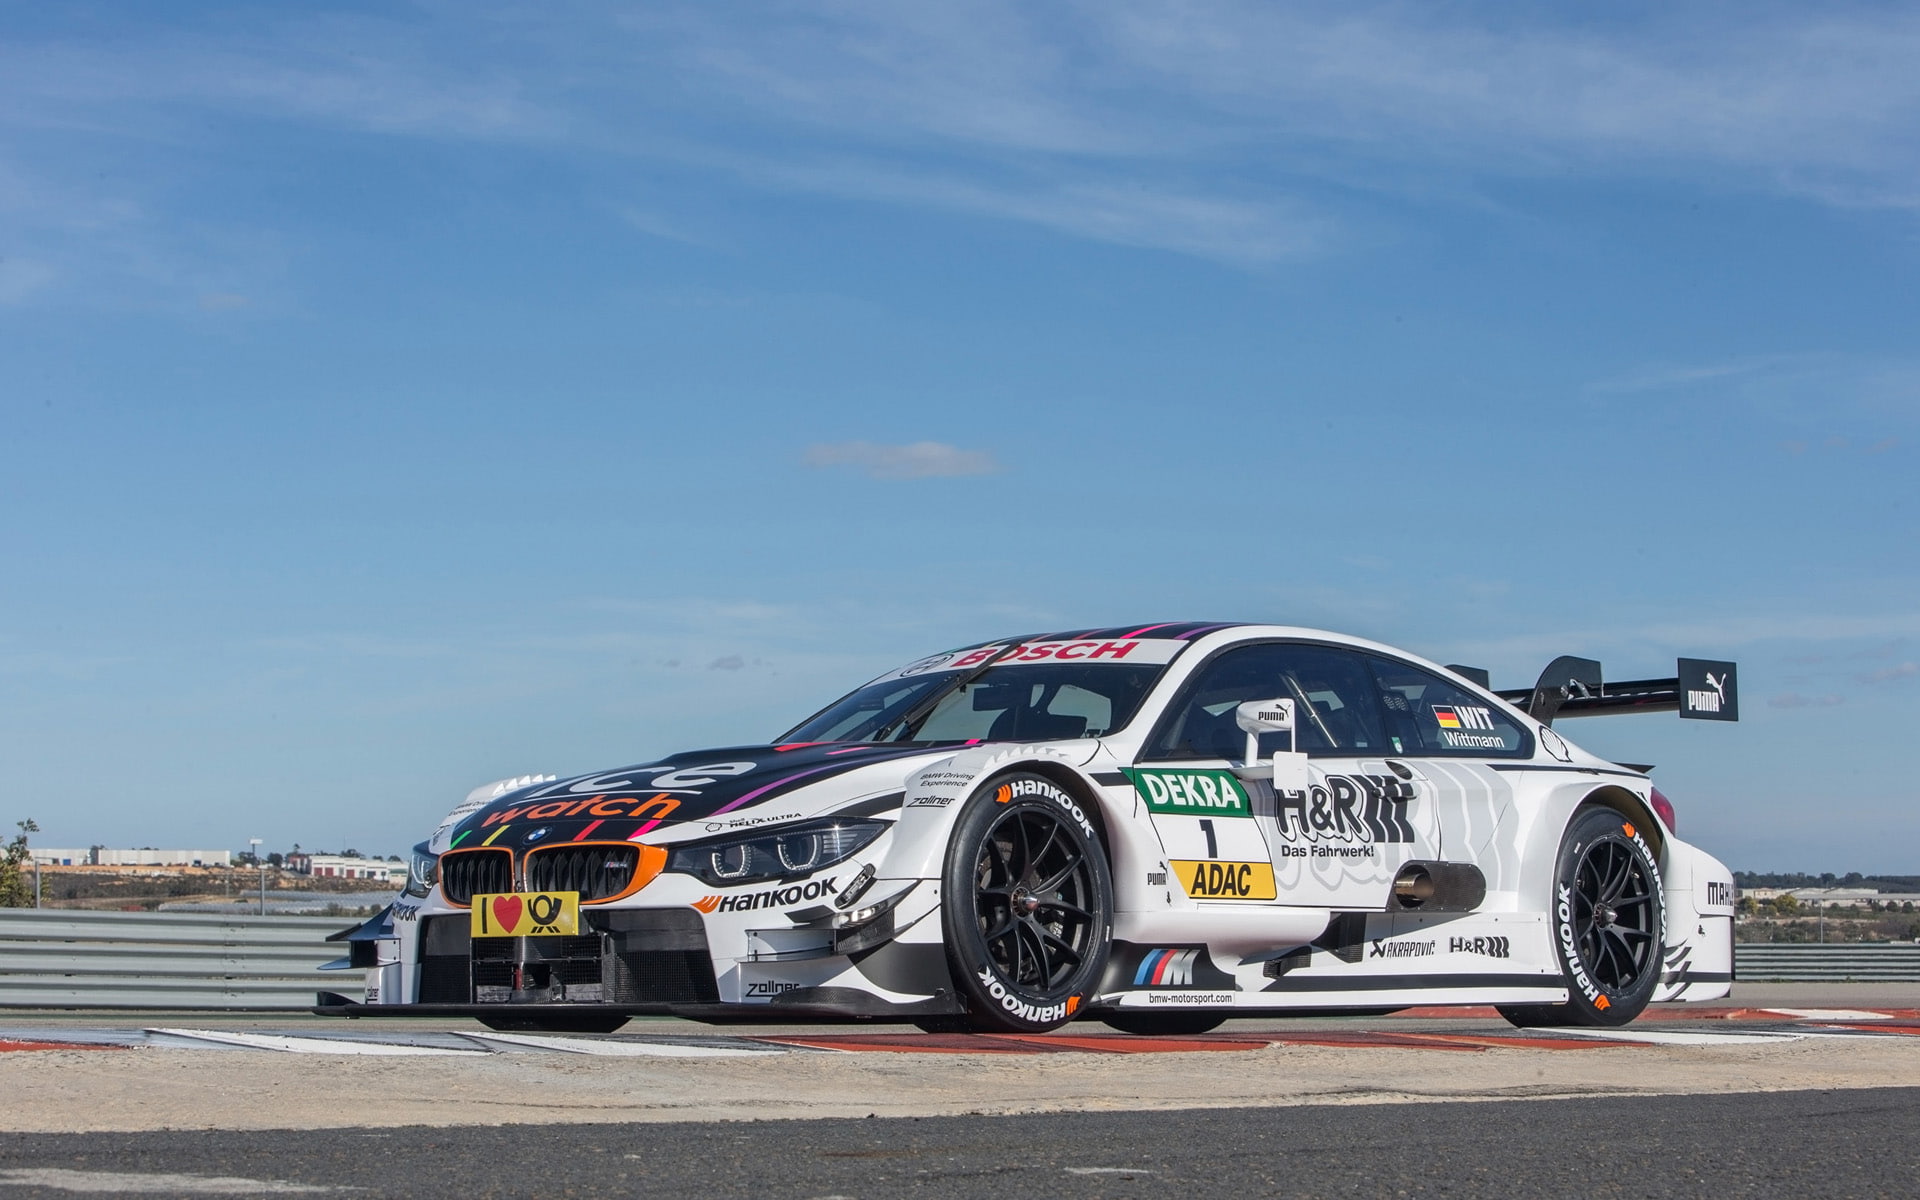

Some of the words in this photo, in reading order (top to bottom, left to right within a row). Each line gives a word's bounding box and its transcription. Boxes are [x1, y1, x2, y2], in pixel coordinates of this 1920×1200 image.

[1688, 690, 1719, 712] PUMA
[1258, 711, 1284, 721] PUMA
[1454, 706, 1495, 730] WIT
[1443, 731, 1505, 748] Wittmann
[944, 772, 975, 780] Driving
[1141, 774, 1241, 808] DEKRA
[907, 795, 955, 808] zollner
[481, 793, 681, 828] watch
[767, 813, 802, 822] ULTRA
[1199, 819, 1218, 859] 1
[1281, 845, 1306, 857] Das
[1311, 845, 1374, 857] Fahrwerk!
[1147, 873, 1166, 885] PUMA
[1190, 863, 1252, 896] ADAC
[1149, 993, 1232, 1006] bmw-motorsport.com
